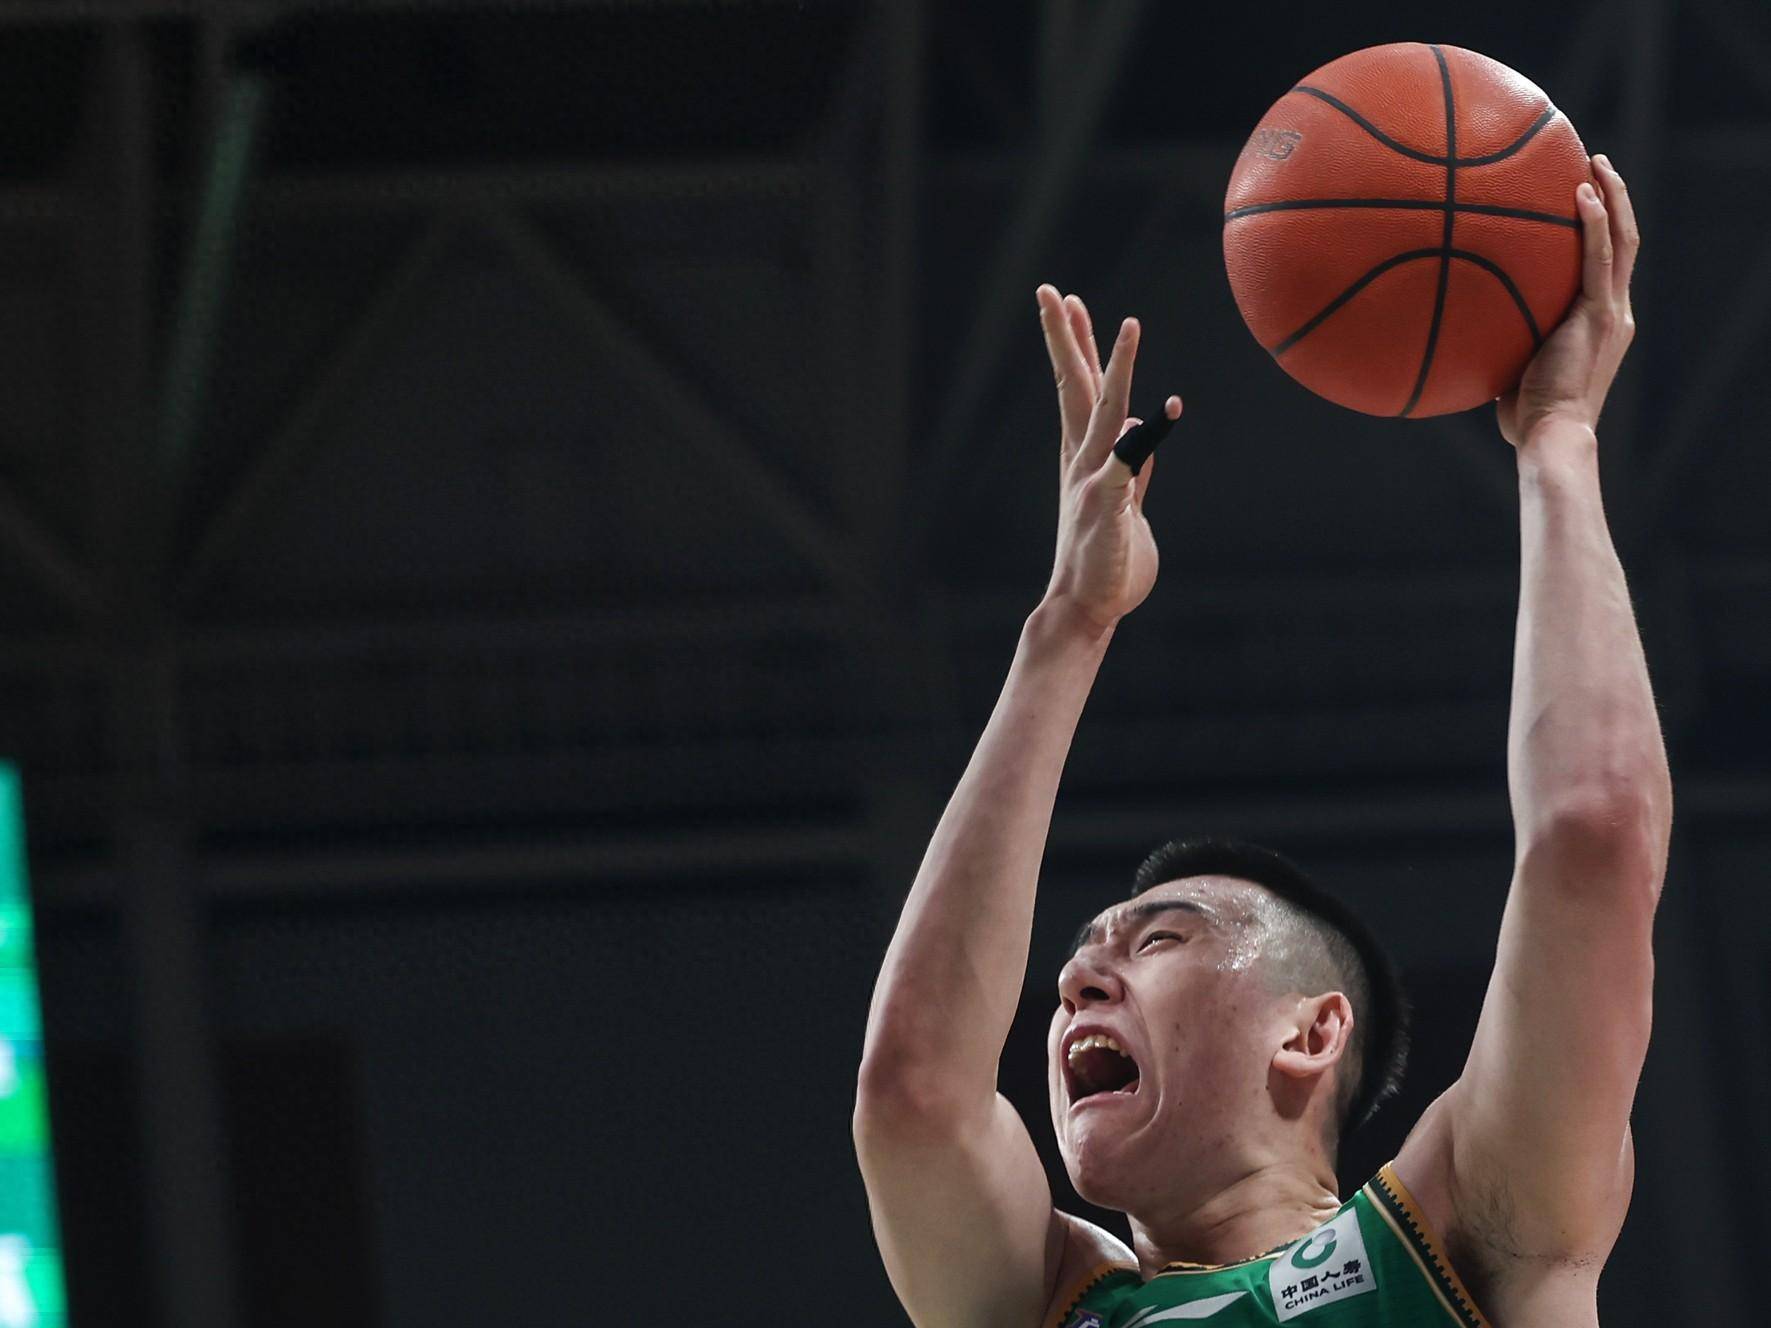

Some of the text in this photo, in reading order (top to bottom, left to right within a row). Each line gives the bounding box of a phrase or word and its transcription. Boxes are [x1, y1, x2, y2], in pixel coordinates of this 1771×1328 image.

[1281, 1259, 1361, 1298] 中国人寿
[1285, 1274, 1365, 1310] CHINA LIFE
